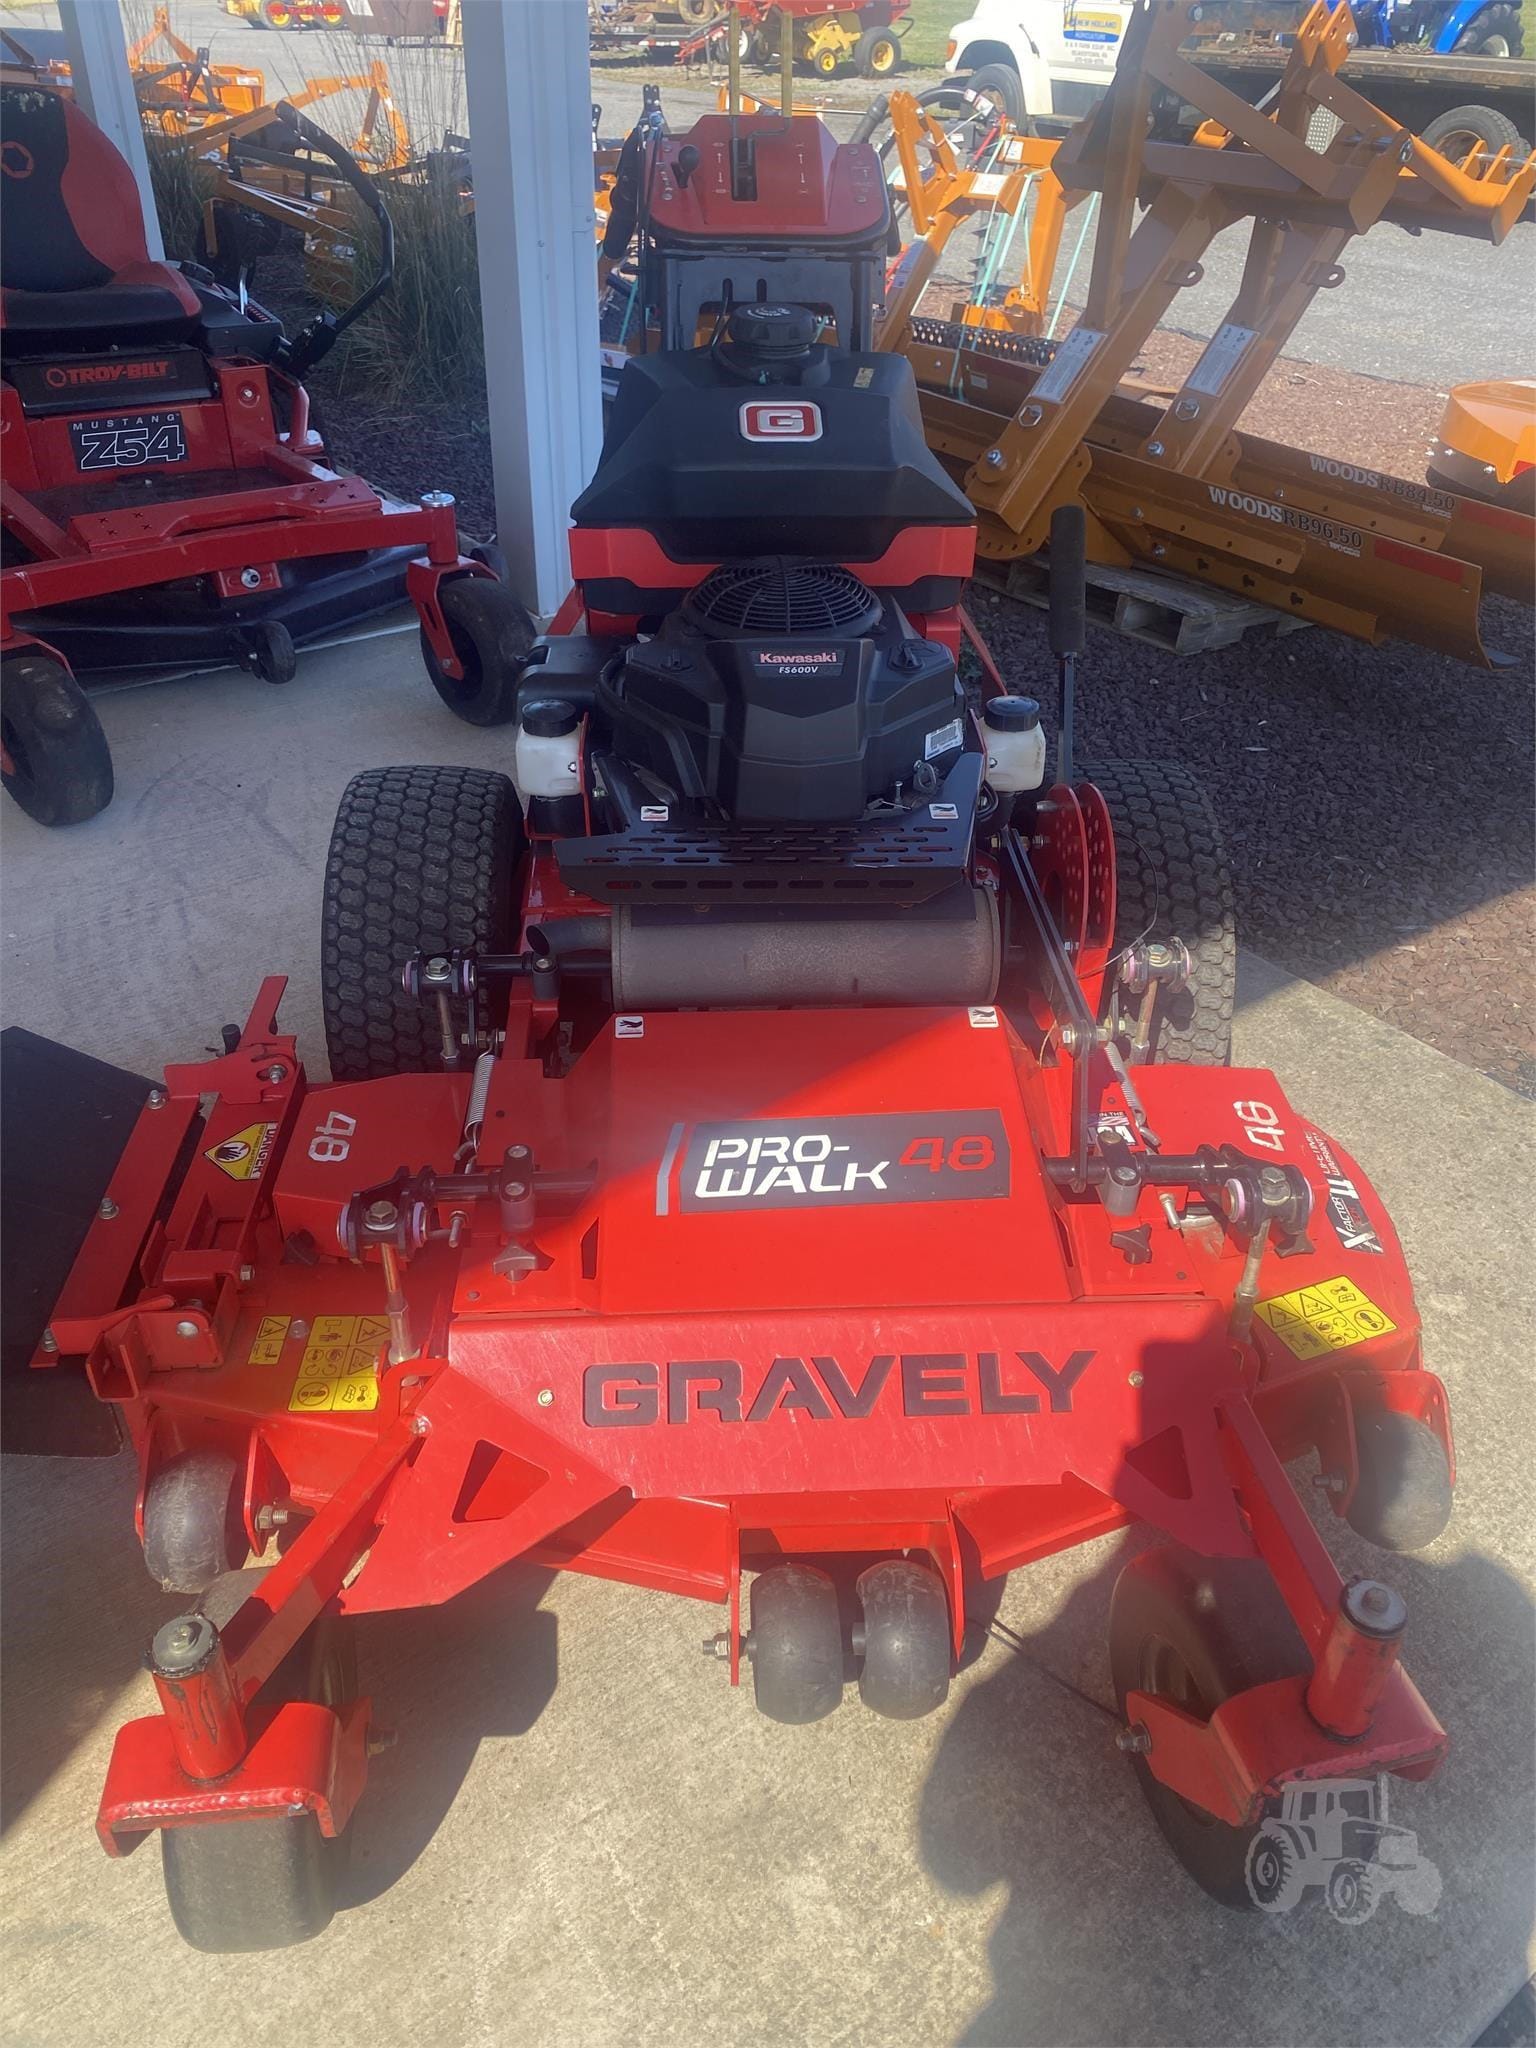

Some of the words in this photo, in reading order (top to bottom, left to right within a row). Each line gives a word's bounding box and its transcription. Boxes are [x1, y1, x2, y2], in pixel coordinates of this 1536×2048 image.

[1091, 20, 1117, 29] HOLLAND
[66, 361, 169, 385] TROY-BILT
[72, 413, 176, 431] MUSTANG
[756, 409, 805, 433] G
[81, 425, 184, 469] Z54
[1309, 455, 1378, 488] WOODS
[1379, 474, 1456, 511] RB84.50
[1208, 486, 1283, 522] WOODS
[1282, 509, 1362, 548] RB96.50
[760, 652, 837, 664] Kawasaki
[779, 666, 818, 674] FS600V
[308, 1111, 357, 1162] 48
[1233, 1101, 1285, 1151] 48
[252, 1128, 277, 1176] DANGER
[703, 1134, 851, 1168] PRO-
[899, 1135, 995, 1173] 48
[1304, 1130, 1331, 1175] LIFETIME
[695, 1161, 890, 1199] WALK
[1331, 1196, 1357, 1233] FACTOR
[582, 1350, 1098, 1428] GRAVELY
